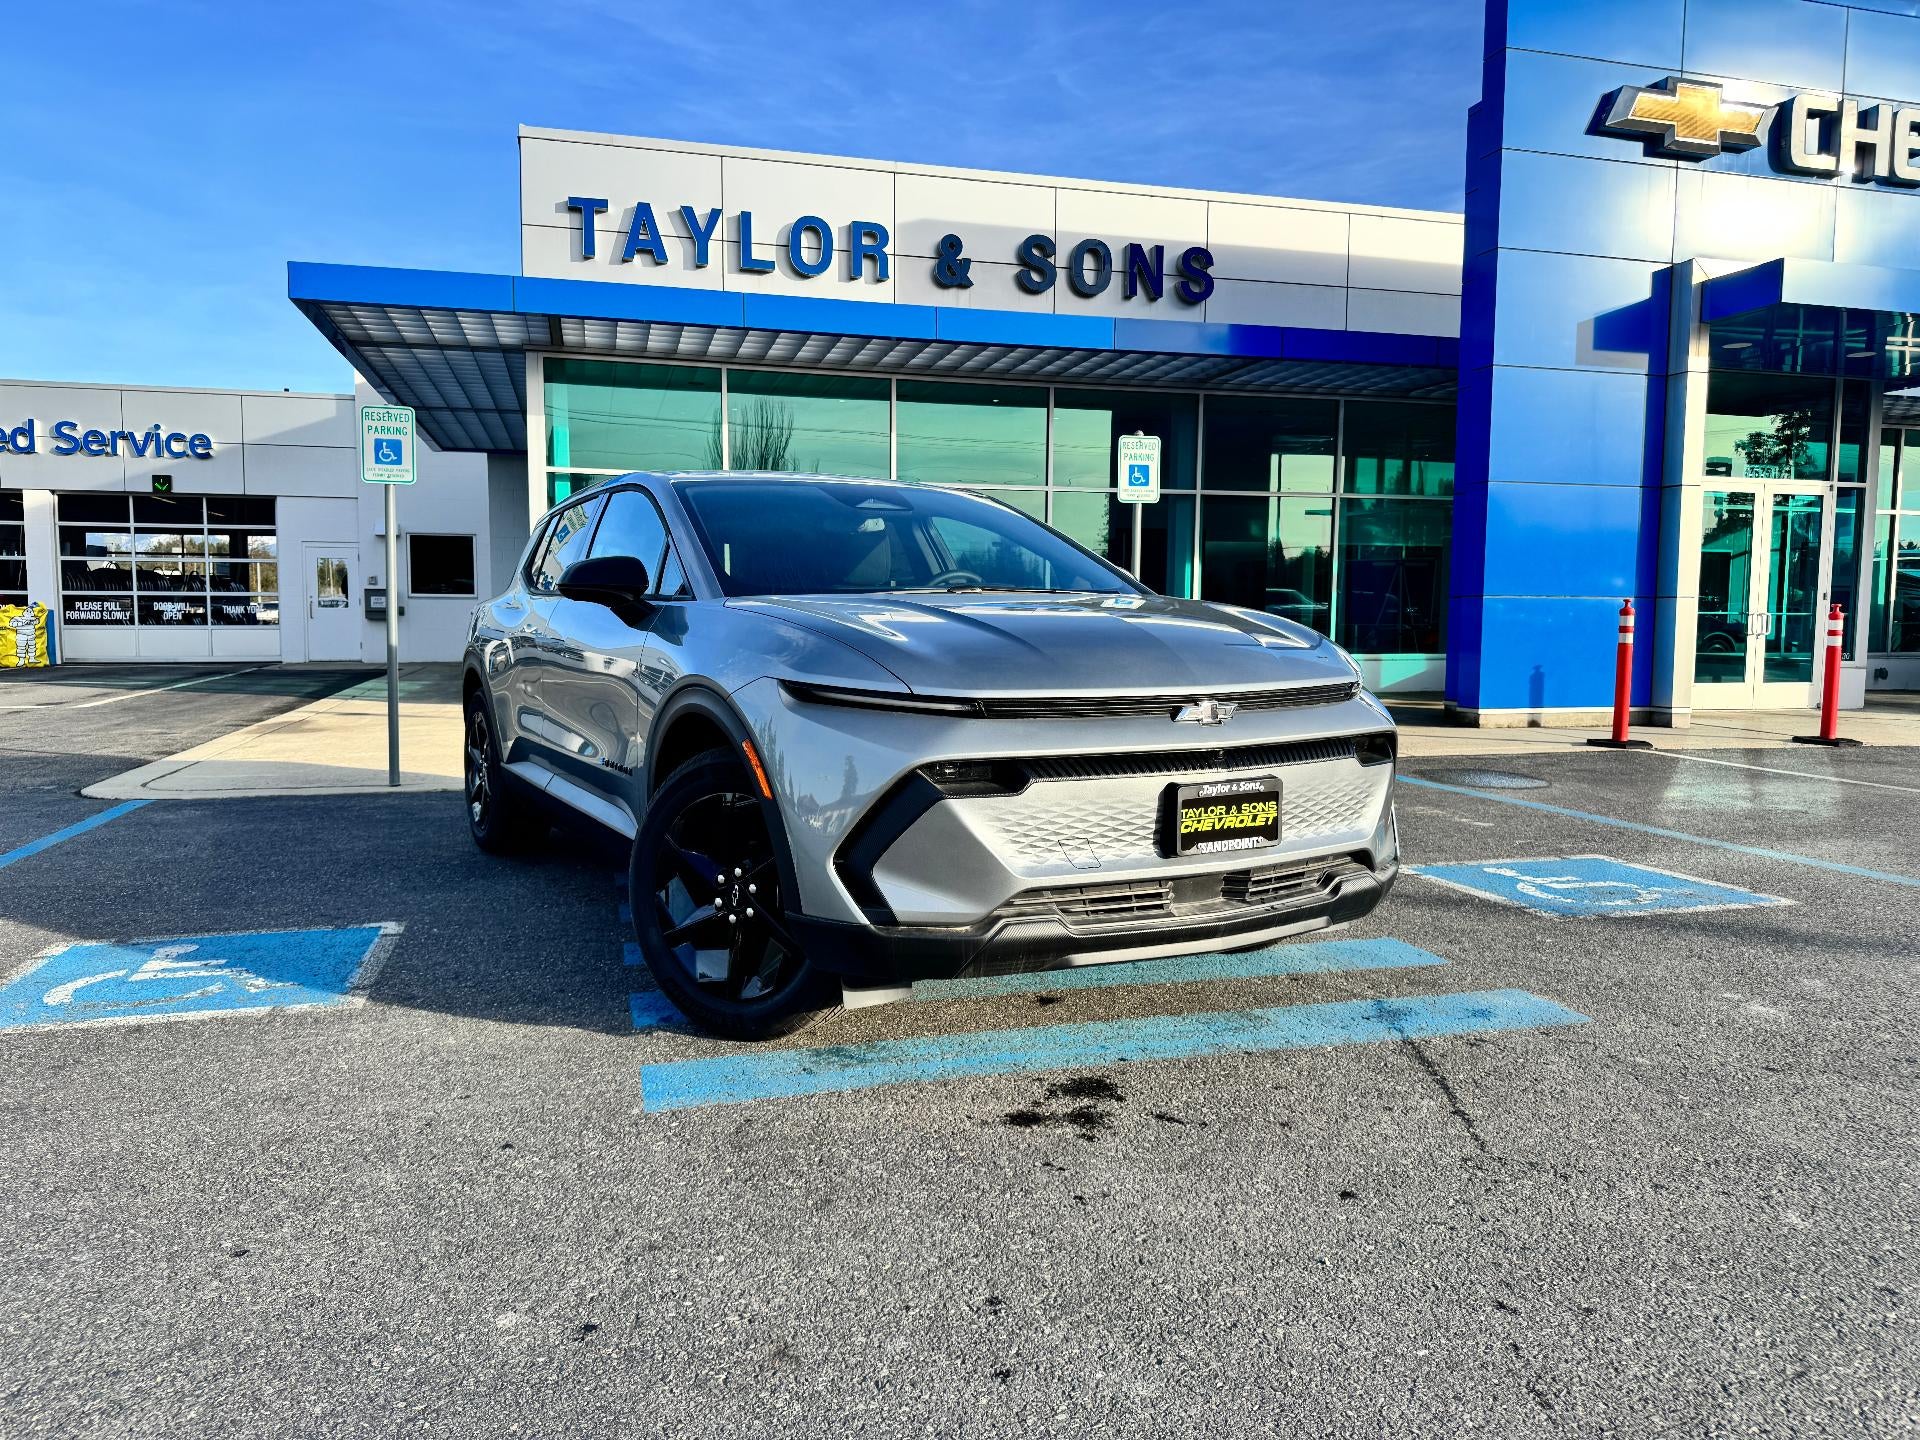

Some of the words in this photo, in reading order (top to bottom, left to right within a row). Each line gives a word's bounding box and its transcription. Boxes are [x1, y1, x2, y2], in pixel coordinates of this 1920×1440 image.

[567, 196, 890, 281] TAYLOR
[933, 233, 975, 288] &
[1015, 234, 1215, 304] SONS
[364, 411, 410, 423] RESERVED
[367, 425, 408, 436] PARKING
[53, 419, 214, 460] Service
[1122, 441, 1157, 450] RESERVED
[1123, 452, 1155, 462] PARKING
[75, 601, 103, 611] PLEASE
[103, 601, 121, 611] PULL
[222, 605, 246, 614] THANK
[65, 610, 102, 620] FORWARD
[102, 610, 131, 620] SLOWLY
[163, 611, 182, 620] OPEN
[1202, 784, 1230, 796] Taylor
[1231, 783, 1238, 791] &
[1239, 781, 1261, 792] Sons
[1181, 806, 1226, 819] TAYLOR
[1229, 805, 1238, 816] &
[1241, 801, 1277, 813] SONS
[1180, 812, 1278, 834] CHEVROLET
[1200, 838, 1260, 854] SANDPOINT
